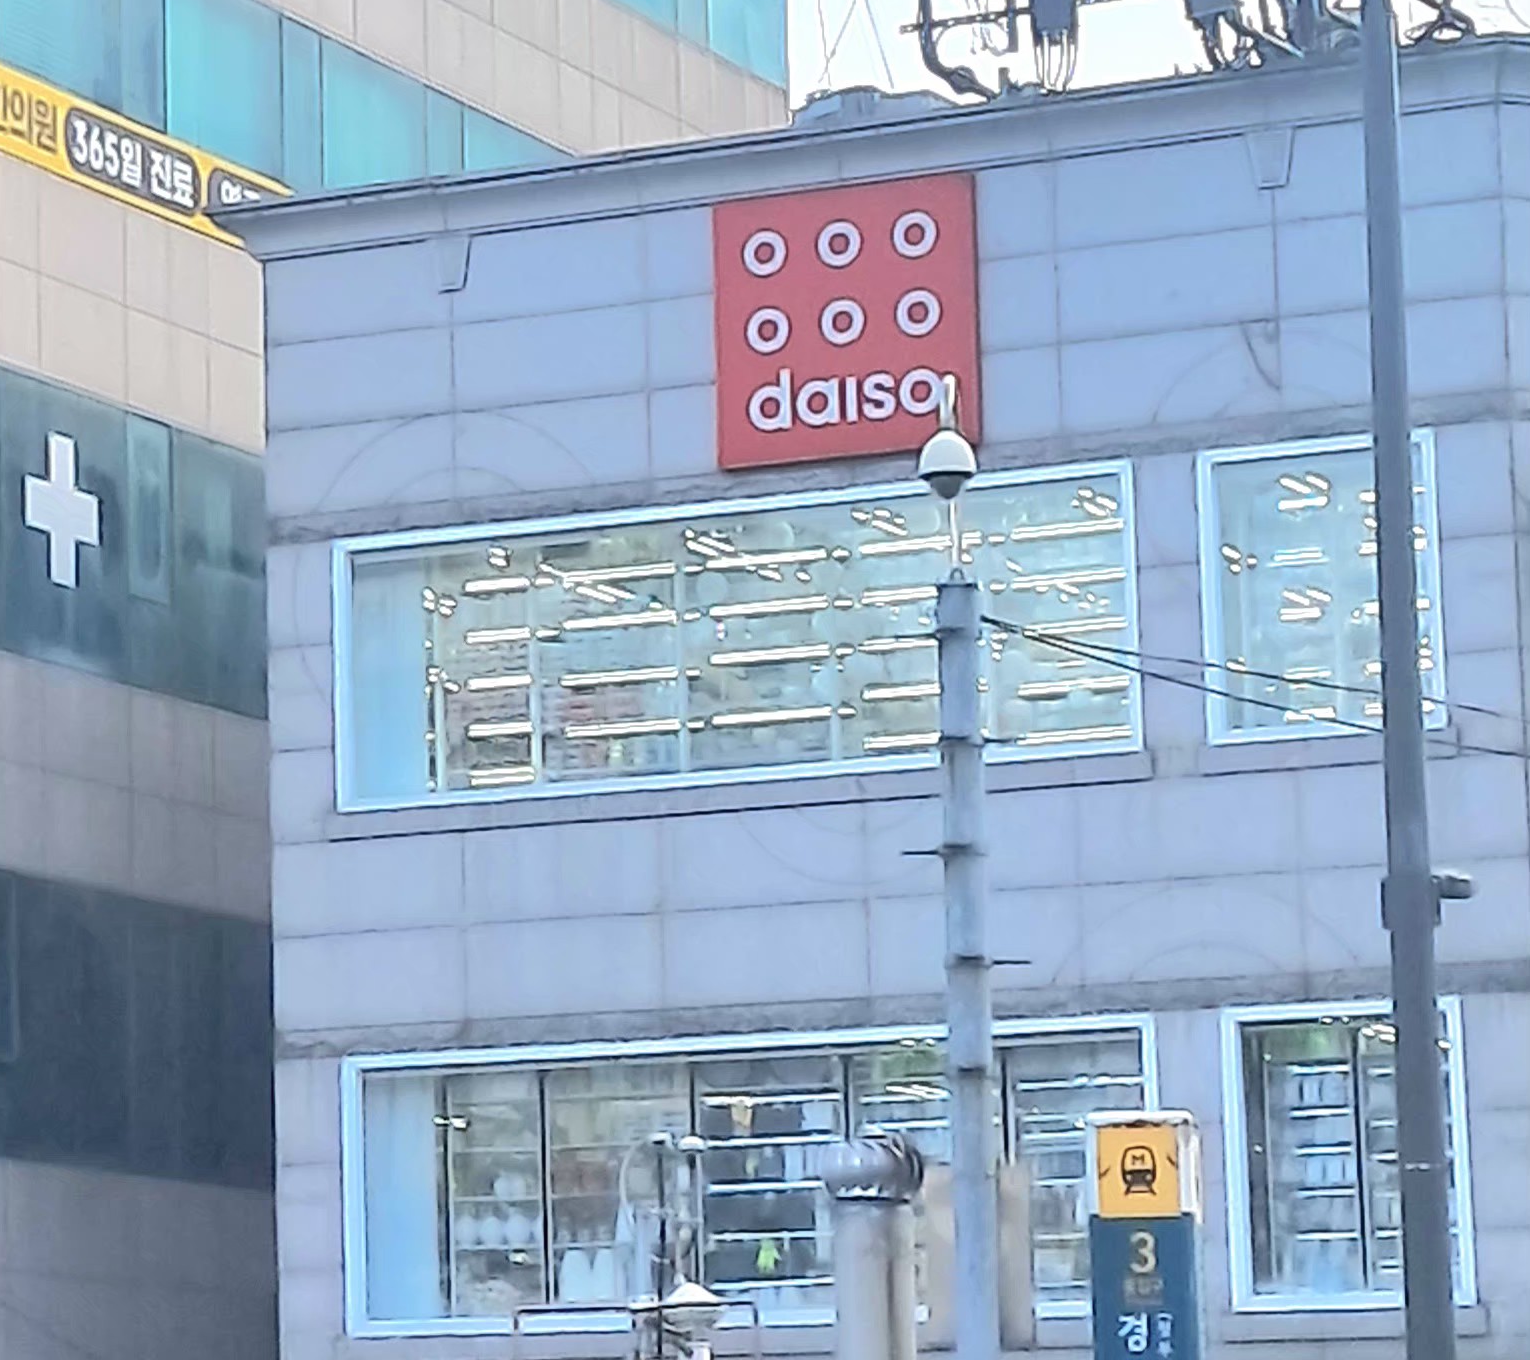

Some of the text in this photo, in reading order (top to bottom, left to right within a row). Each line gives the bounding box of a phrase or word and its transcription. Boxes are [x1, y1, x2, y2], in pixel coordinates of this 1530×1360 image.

[71, 118, 143, 188] 365일
[148, 148, 198, 210] 진료
[748, 367, 942, 432] daiso
[1129, 1231, 1157, 1274] 3
